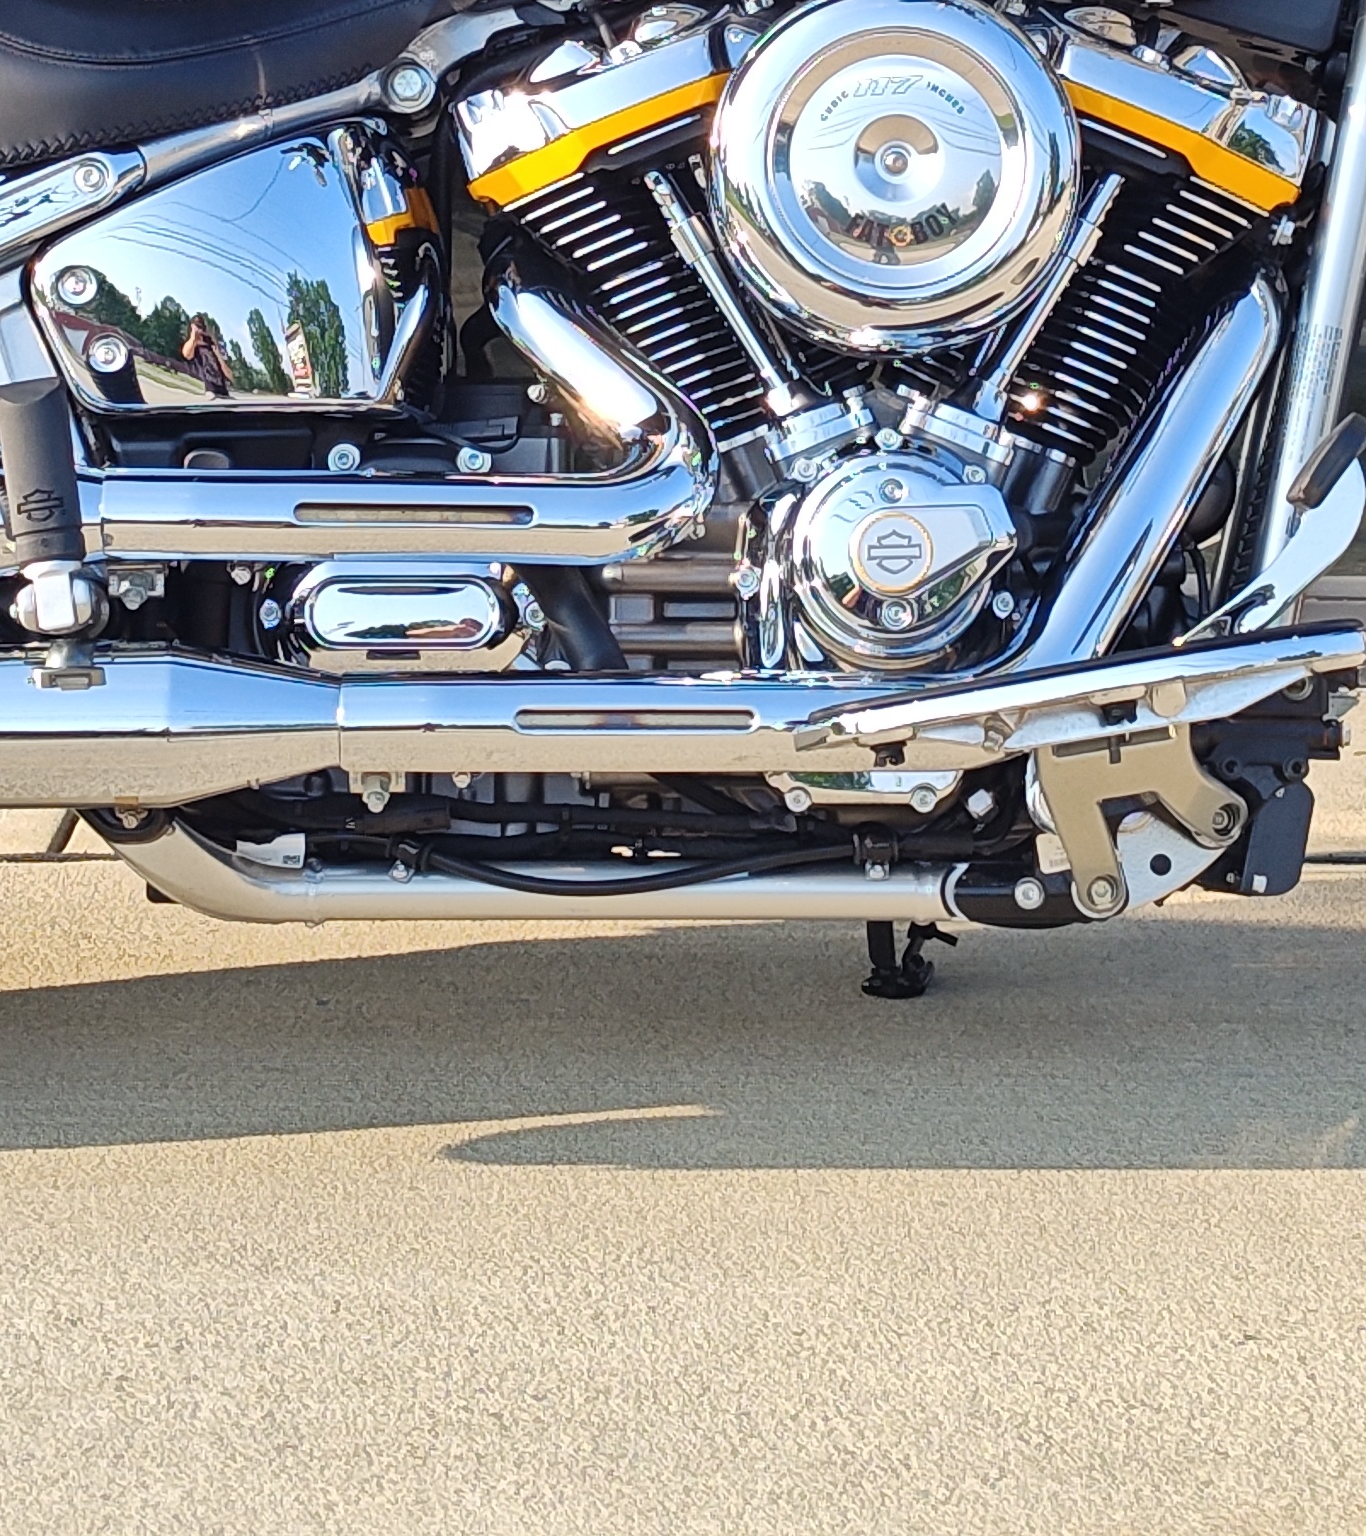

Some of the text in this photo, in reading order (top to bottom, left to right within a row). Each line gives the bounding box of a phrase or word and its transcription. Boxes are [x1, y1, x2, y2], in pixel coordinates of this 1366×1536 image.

[820, 75, 965, 122] CUBIC 117 INCHES
[845, 202, 958, 247] FAT BOY
